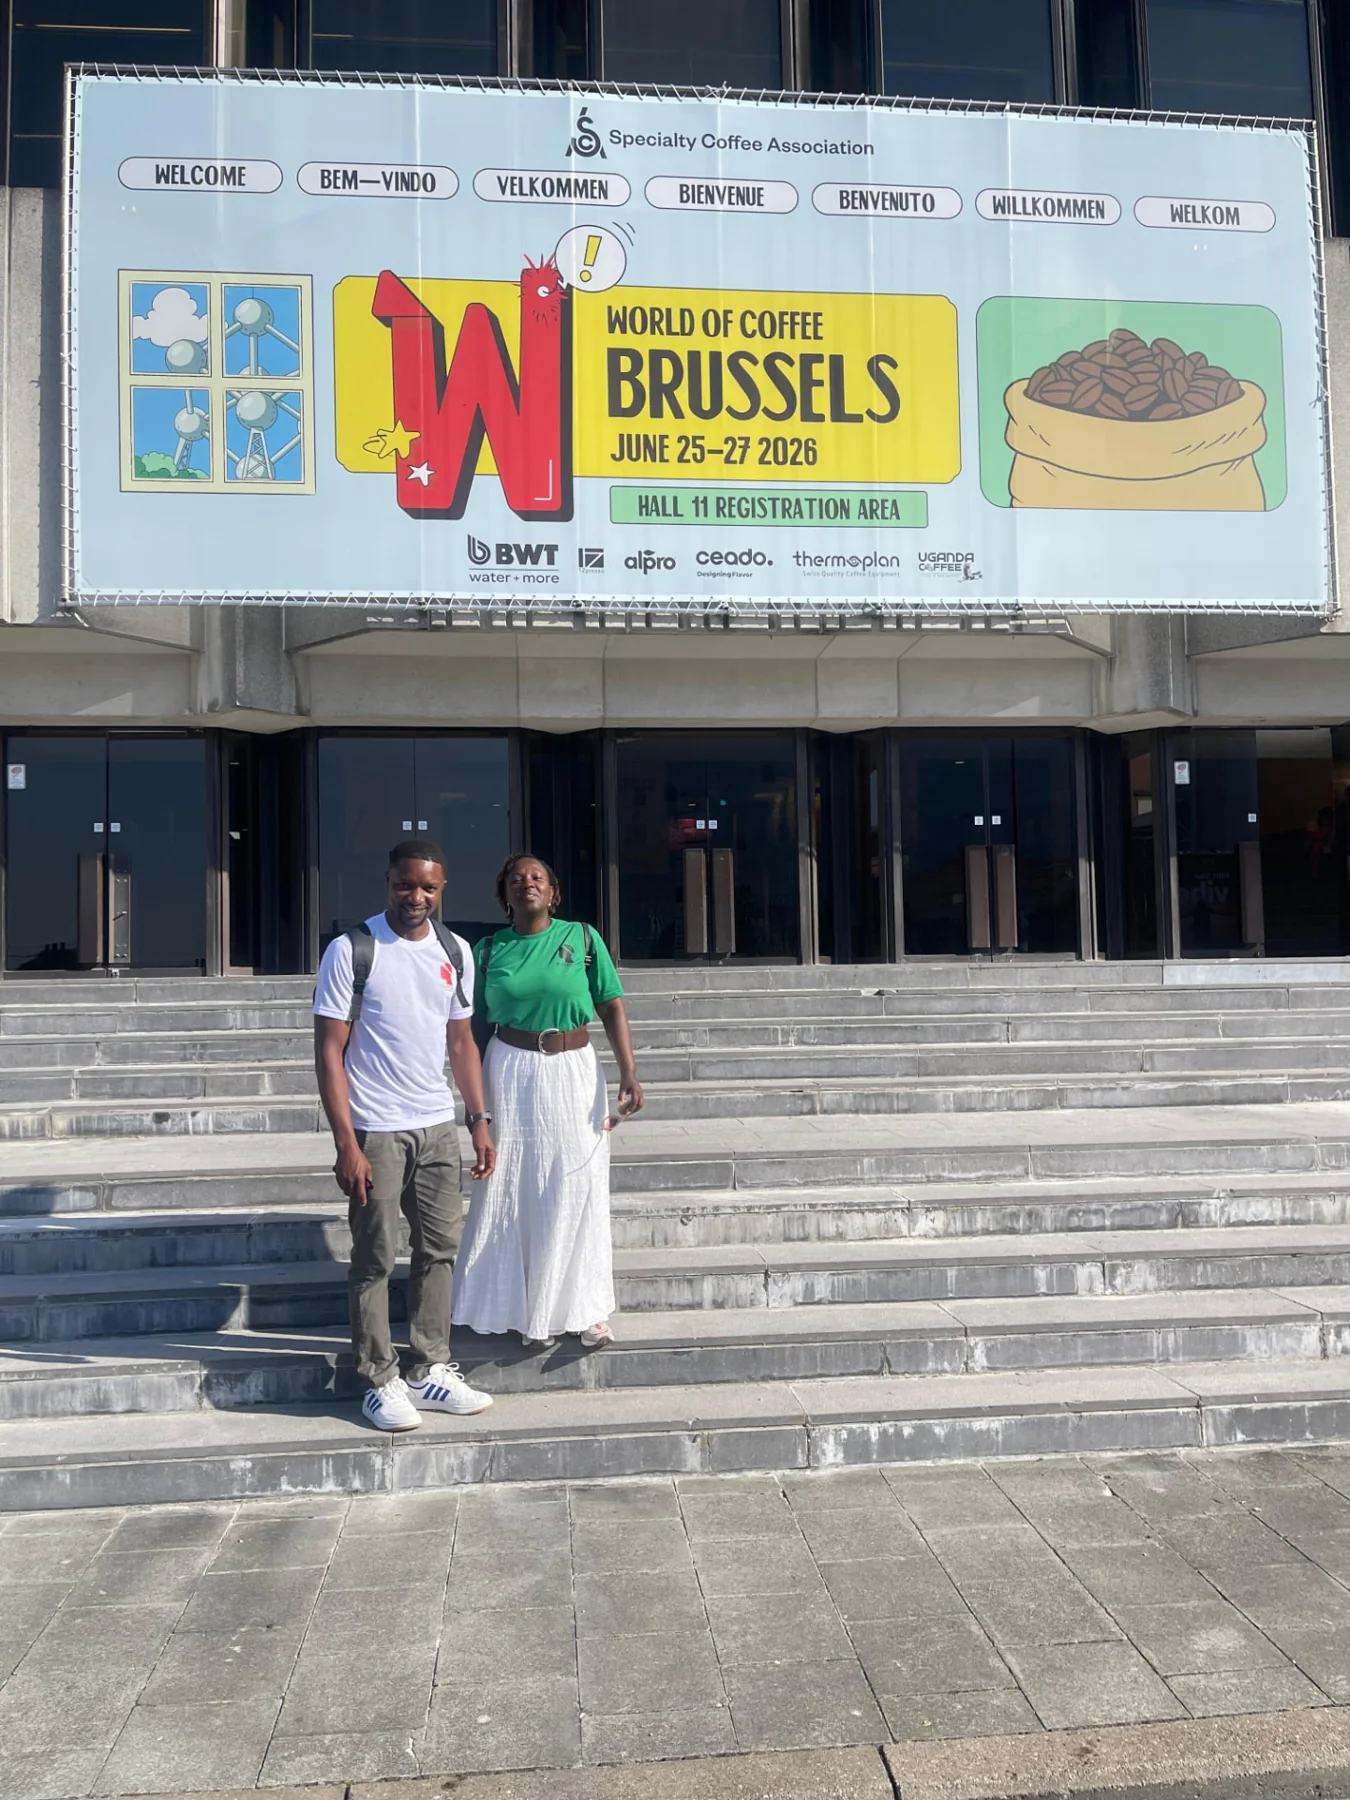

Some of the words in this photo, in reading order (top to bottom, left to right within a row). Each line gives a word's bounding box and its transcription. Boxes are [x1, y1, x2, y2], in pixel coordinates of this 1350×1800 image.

[609, 129, 697, 152] Specialty
[701, 132, 763, 152] Coffee
[767, 135, 875, 156] Association
[155, 164, 246, 187] WELCOME
[497, 175, 609, 201] VELKOMMEN
[679, 184, 765, 208] BIENVENUE
[839, 190, 936, 214] BENVENUTO
[992, 195, 1106, 221] WILLKOMMEN
[1170, 203, 1241, 226] WELKOM
[607, 305, 695, 337] WORLD
[702, 309, 733, 338] OF
[740, 310, 824, 340] COFFEE
[607, 347, 900, 424] BRUSSELS
[610, 433, 670, 463] JUNE
[758, 437, 818, 466] 2026
[638, 495, 684, 517] HALL
[692, 495, 708, 518] 11
[716, 496, 850, 519] REGISTRATION
[858, 498, 901, 521] AREA
[495, 543, 559, 566] BWT
[624, 549, 677, 575] alpro
[918, 552, 974, 563] UGANDA
[469, 572, 511, 583] water
[522, 573, 560, 583] more
